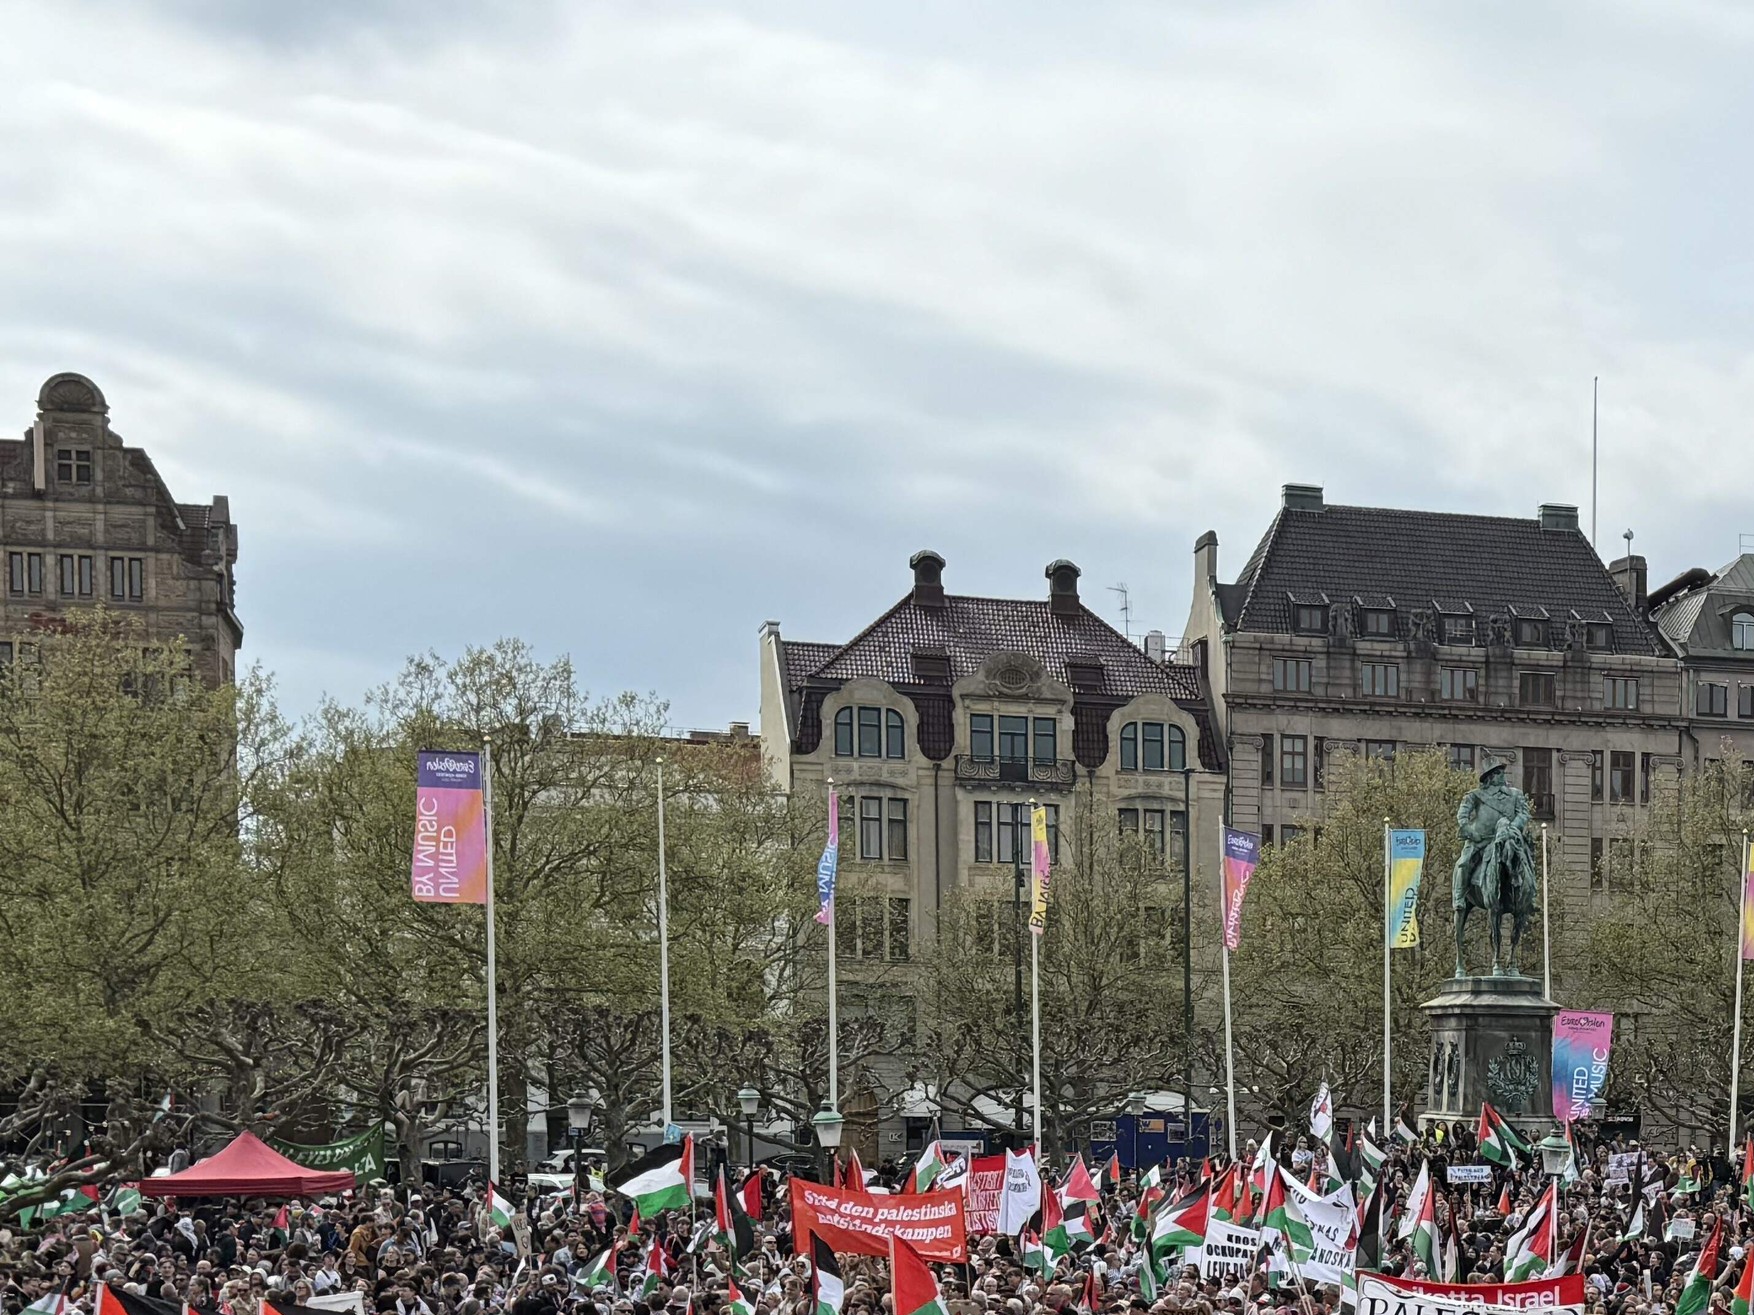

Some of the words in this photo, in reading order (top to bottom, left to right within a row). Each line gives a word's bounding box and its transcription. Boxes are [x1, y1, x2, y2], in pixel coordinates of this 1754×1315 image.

[1568, 1067, 1589, 1121] UNITED
[839, 1200, 874, 1217] den
[873, 1200, 957, 1222] palestinska
[1498, 1286, 1561, 1308] Israel
